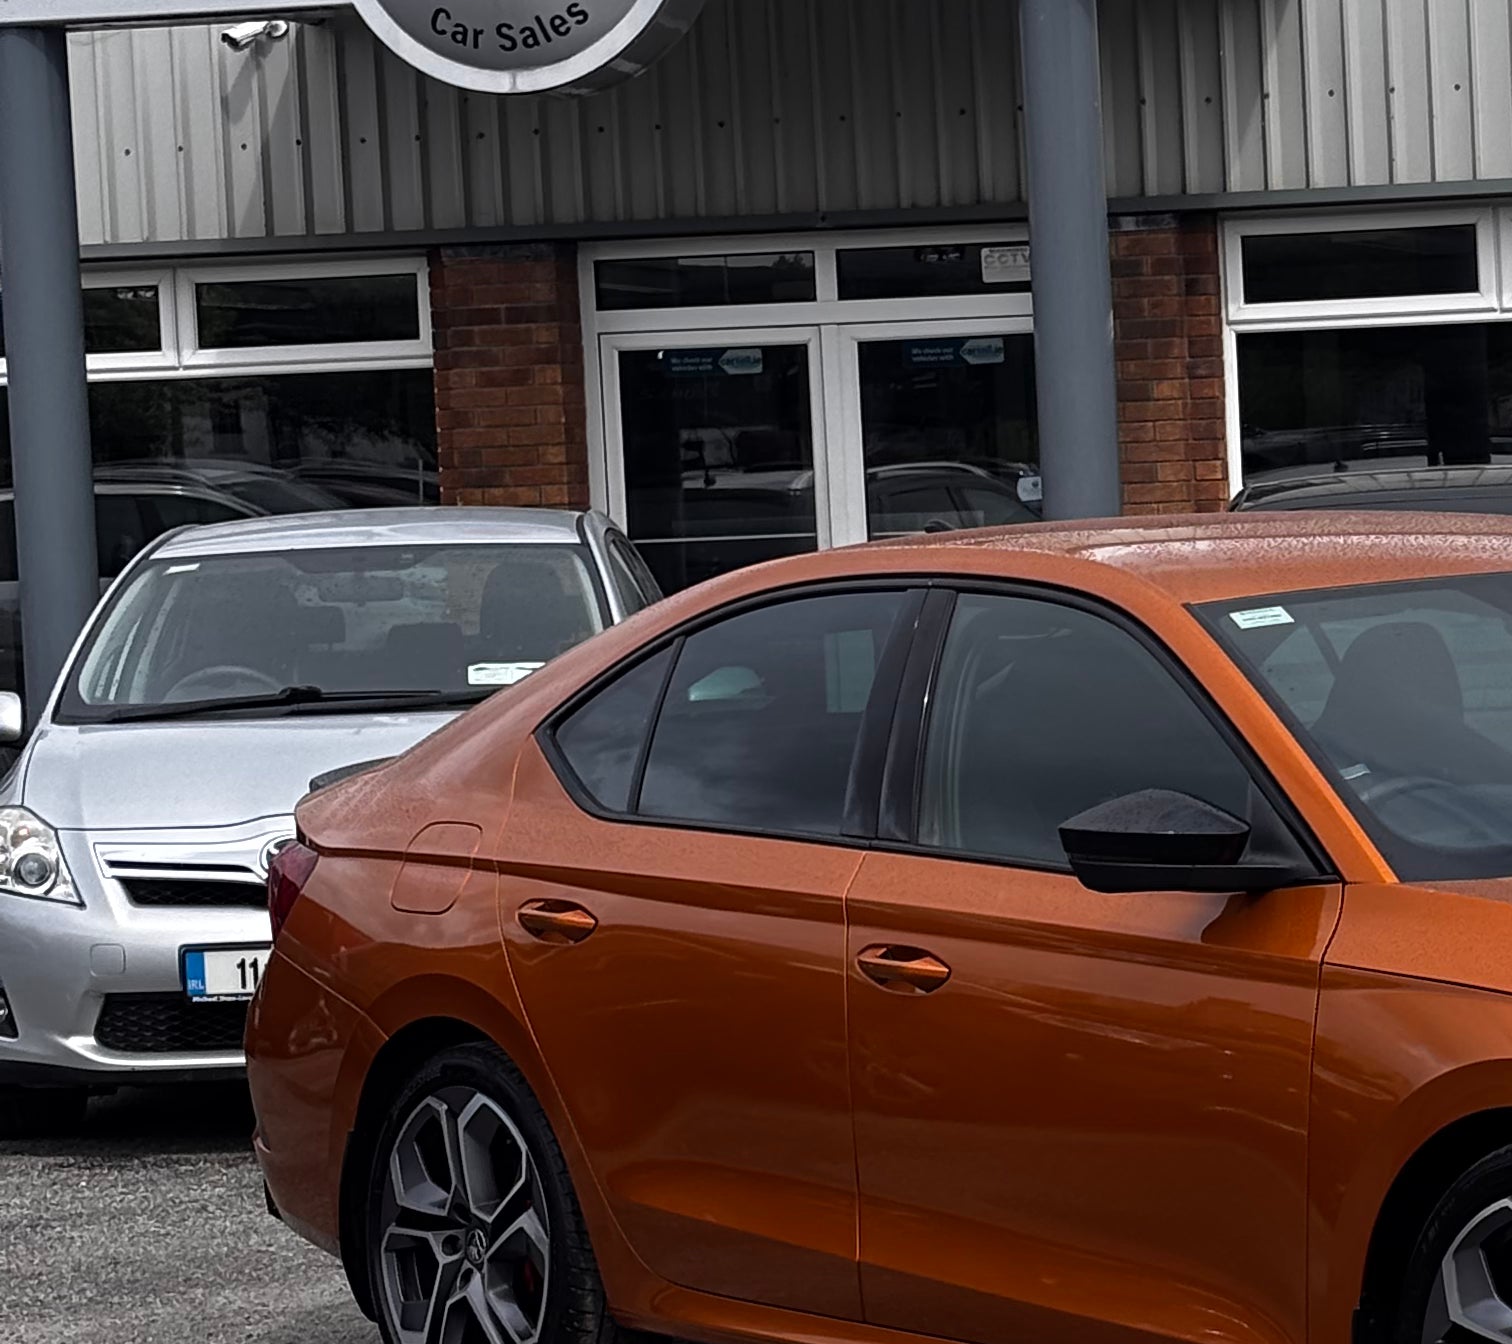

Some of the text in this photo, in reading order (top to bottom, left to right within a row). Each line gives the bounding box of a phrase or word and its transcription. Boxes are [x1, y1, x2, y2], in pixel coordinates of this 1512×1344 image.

[430, 1, 590, 52] Car Sales
[984, 252, 1030, 265] CCTV
[188, 980, 204, 990] IRL
